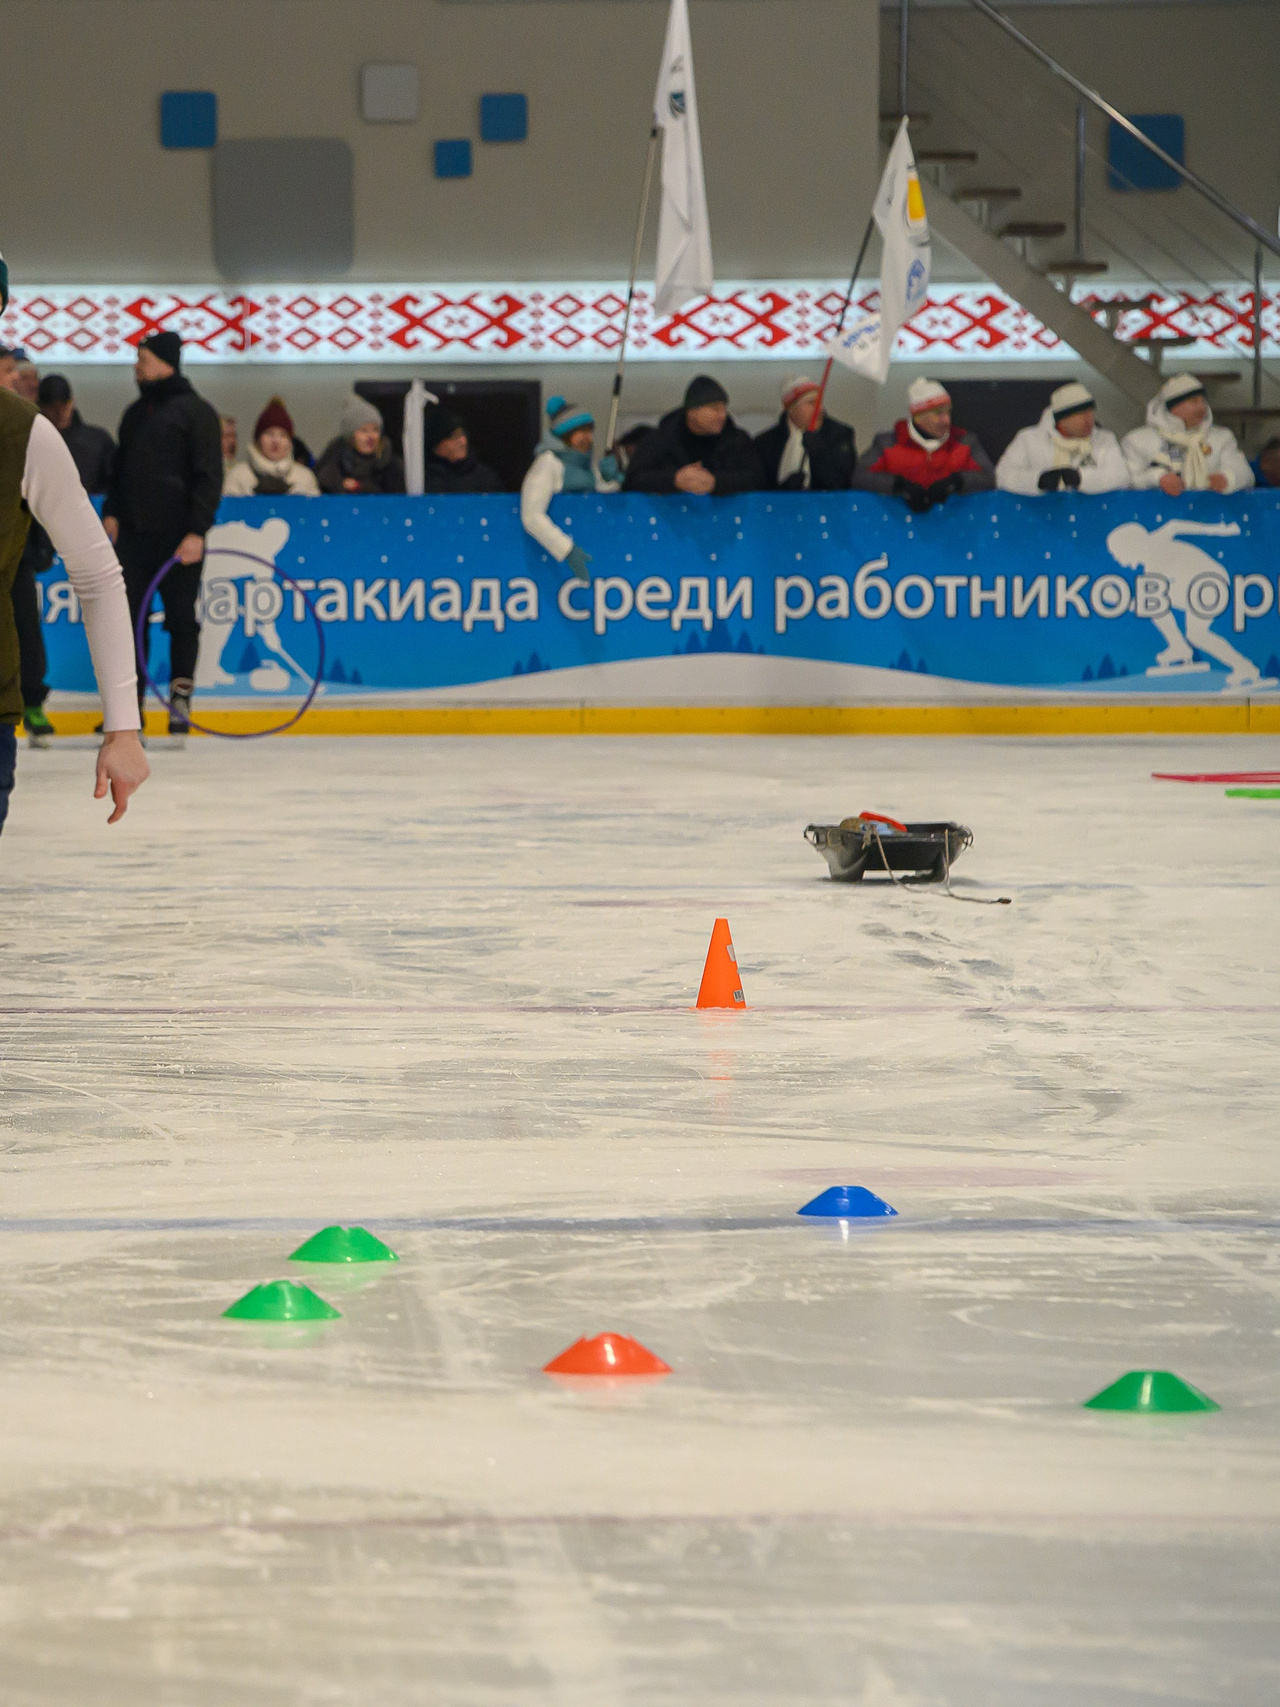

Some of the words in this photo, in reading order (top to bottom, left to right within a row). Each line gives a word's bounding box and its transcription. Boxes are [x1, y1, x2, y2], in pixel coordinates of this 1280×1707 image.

[148, 576, 538, 636] артакиада
[558, 576, 753, 634] среди
[774, 555, 1172, 633] работников
[1187, 571, 1280, 633] ор
